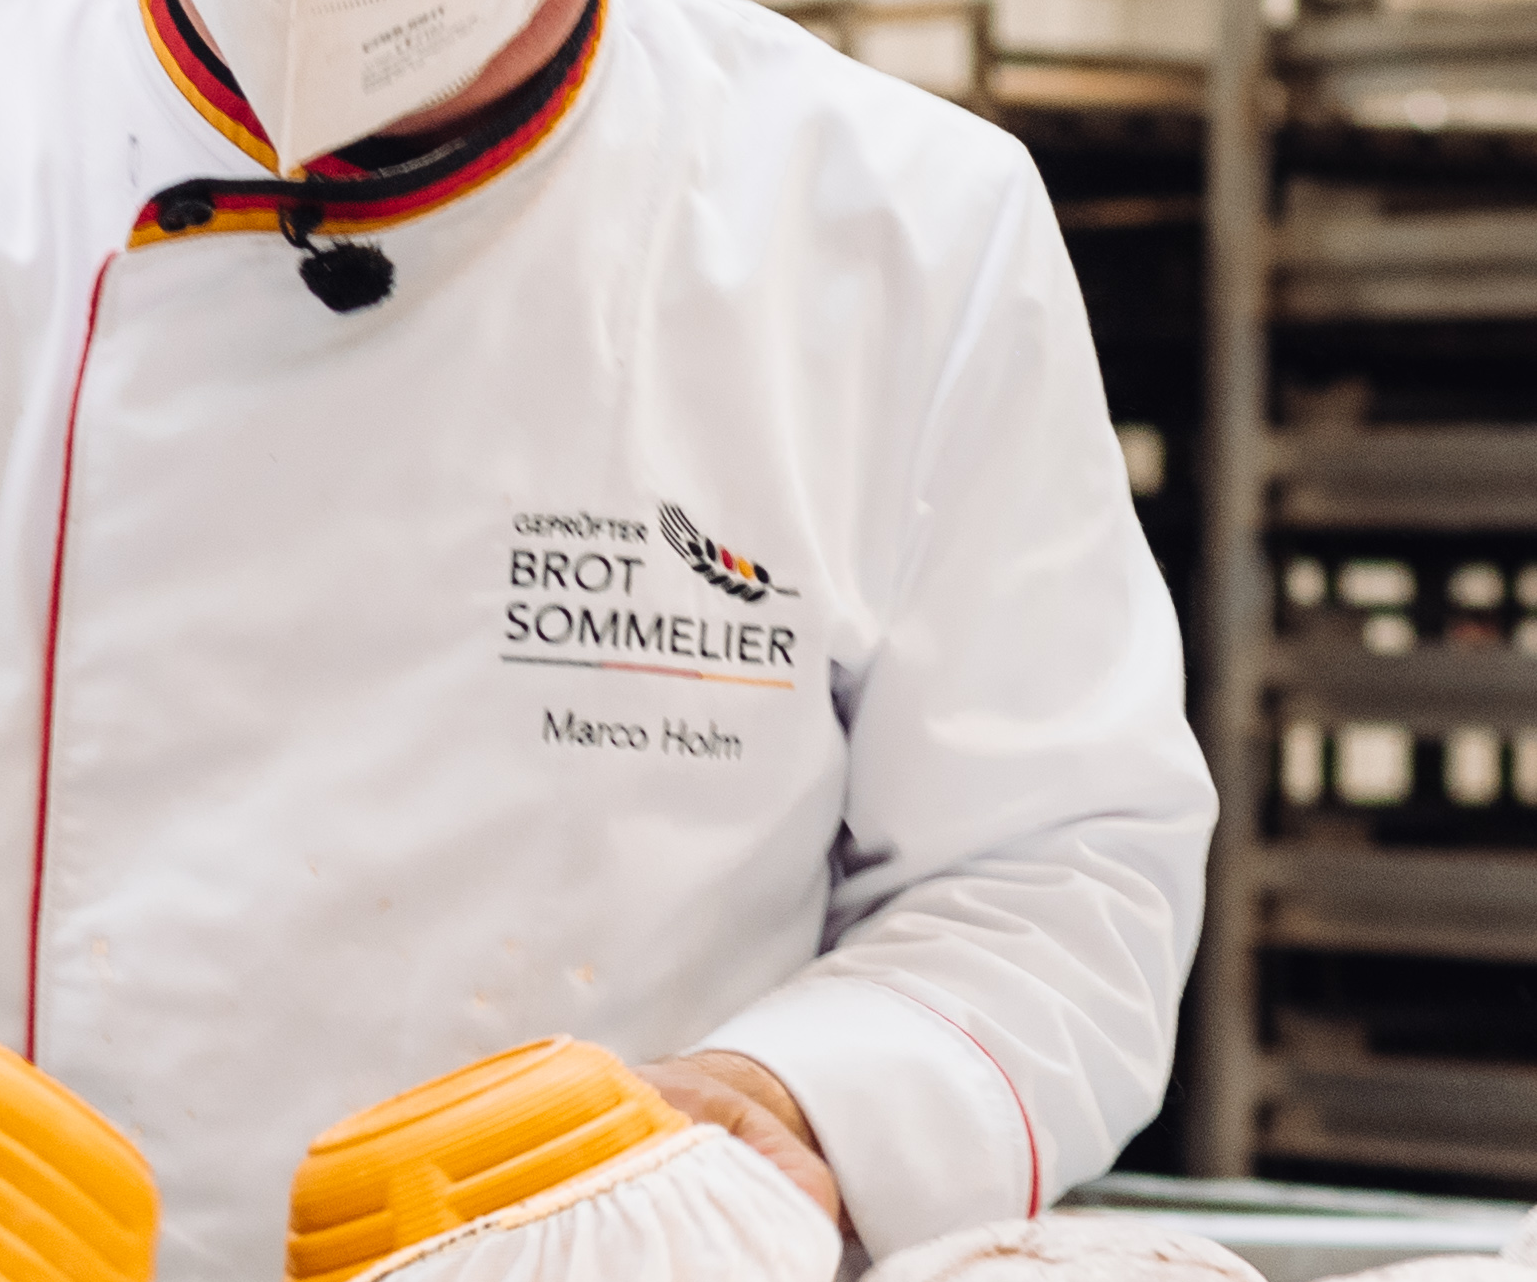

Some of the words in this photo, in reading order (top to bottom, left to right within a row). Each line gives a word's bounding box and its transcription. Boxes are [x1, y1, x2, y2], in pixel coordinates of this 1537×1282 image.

[513, 510, 649, 544] GEPRÜFTER
[510, 547, 646, 597] BROT
[504, 600, 797, 667] SOMMELIER
[542, 707, 650, 751] Marco
[660, 716, 744, 761] Holm
